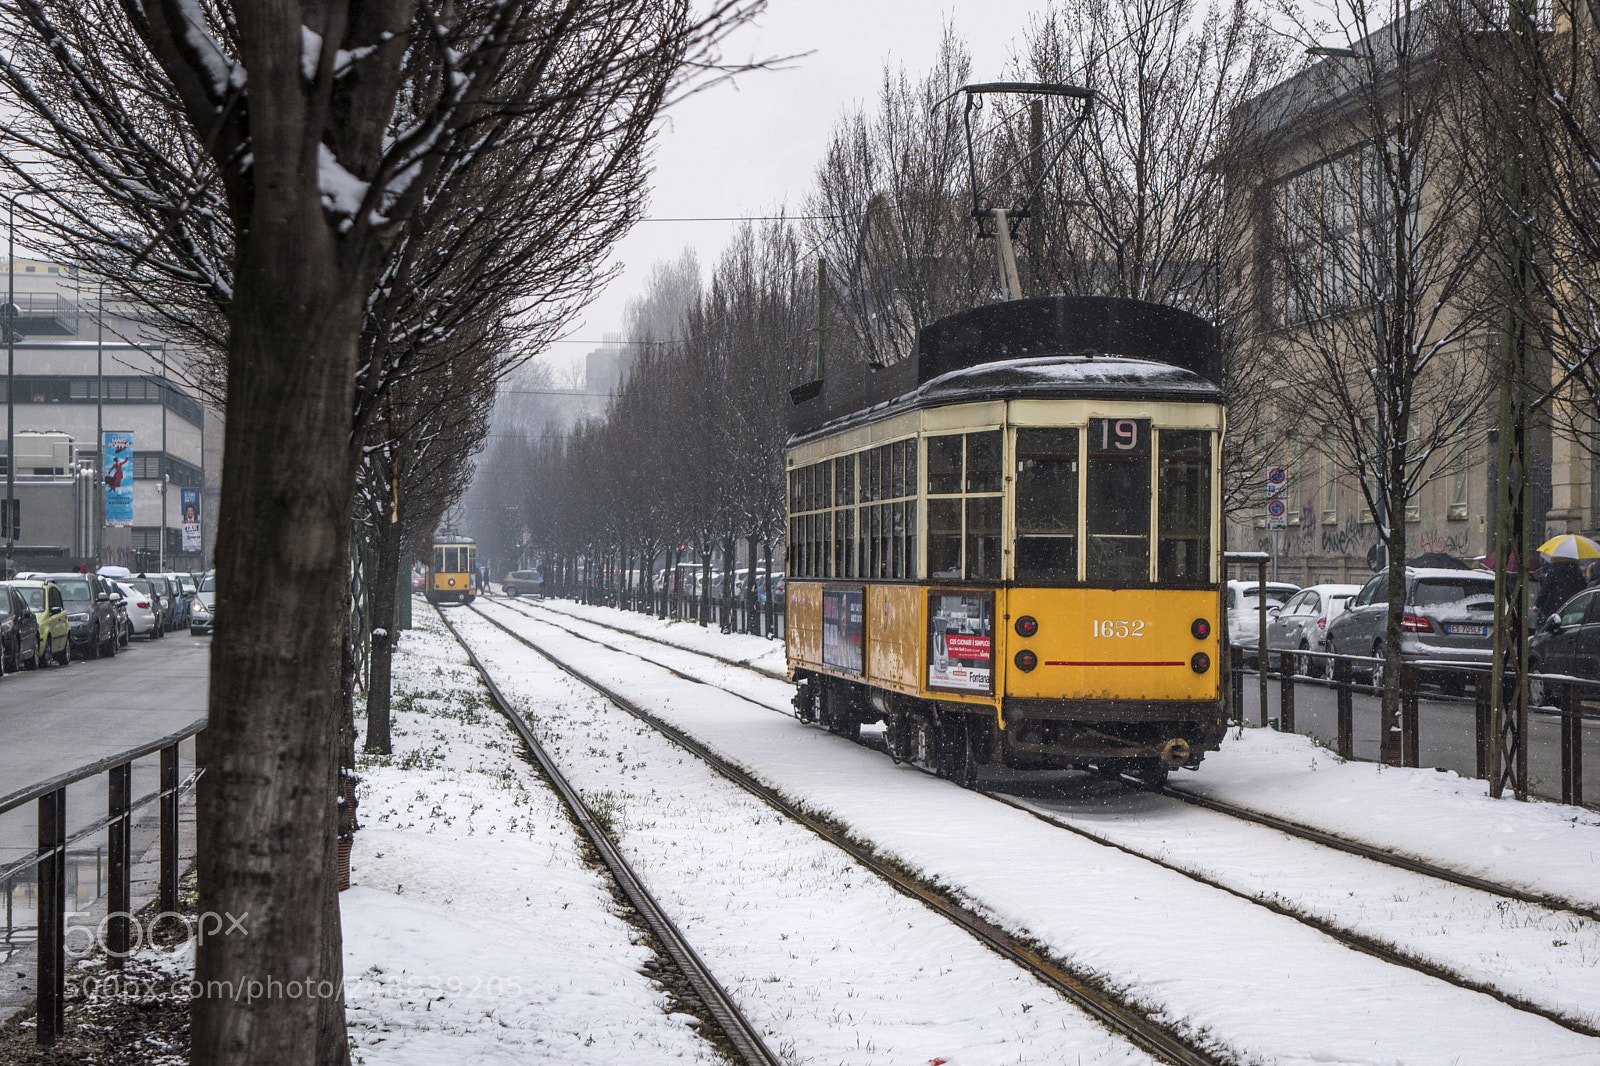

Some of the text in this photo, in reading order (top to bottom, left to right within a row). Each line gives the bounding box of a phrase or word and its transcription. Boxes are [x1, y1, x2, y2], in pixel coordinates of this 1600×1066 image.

[1100, 419, 1139, 450] 19
[1092, 619, 1146, 639] 1652
[970, 672, 990, 684] Fontana
